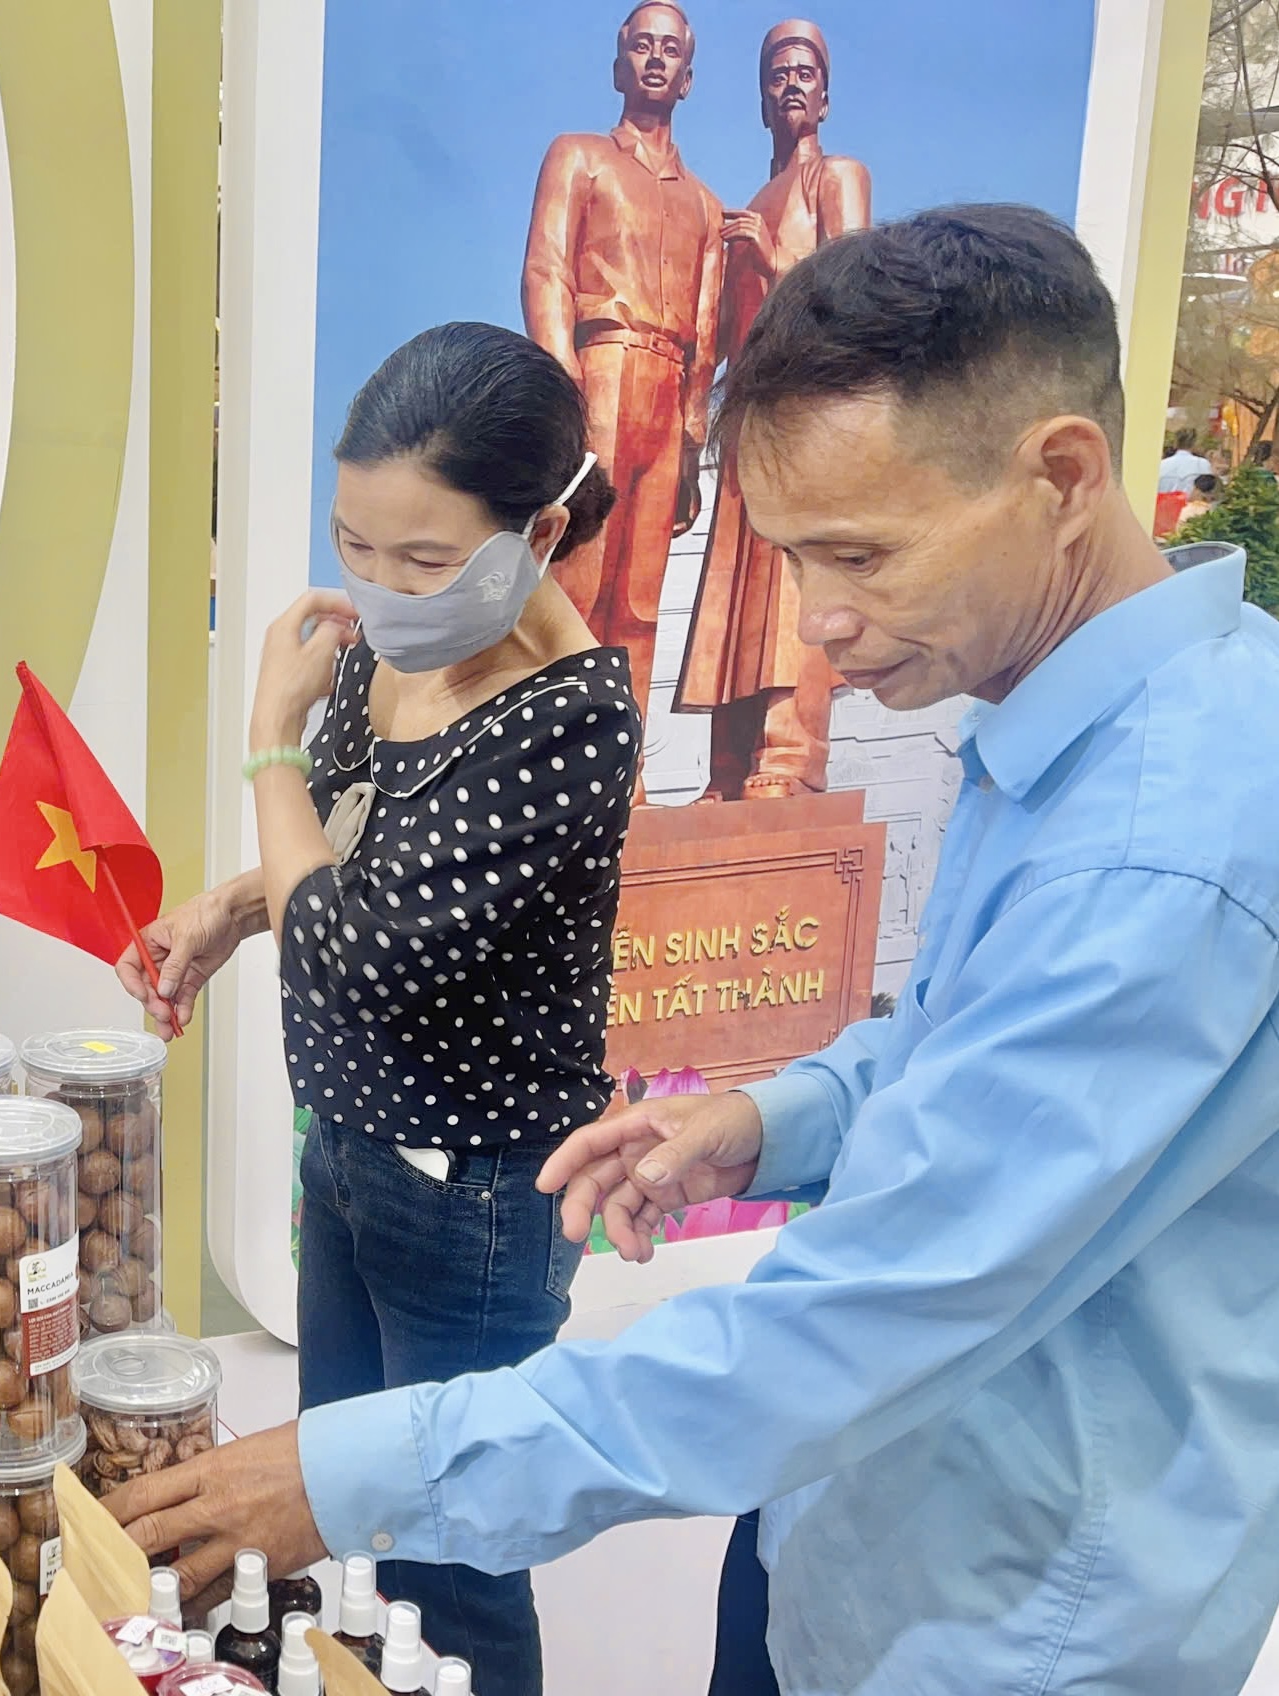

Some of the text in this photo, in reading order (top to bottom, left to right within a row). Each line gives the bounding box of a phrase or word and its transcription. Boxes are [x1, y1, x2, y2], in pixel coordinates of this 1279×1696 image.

[664, 924, 740, 965] SINH
[750, 904, 820, 956] SẮC
[652, 973, 708, 1022] TẤT
[715, 966, 825, 1014] THÀNH
[26, 1271, 74, 1295] MACCADAMIA
